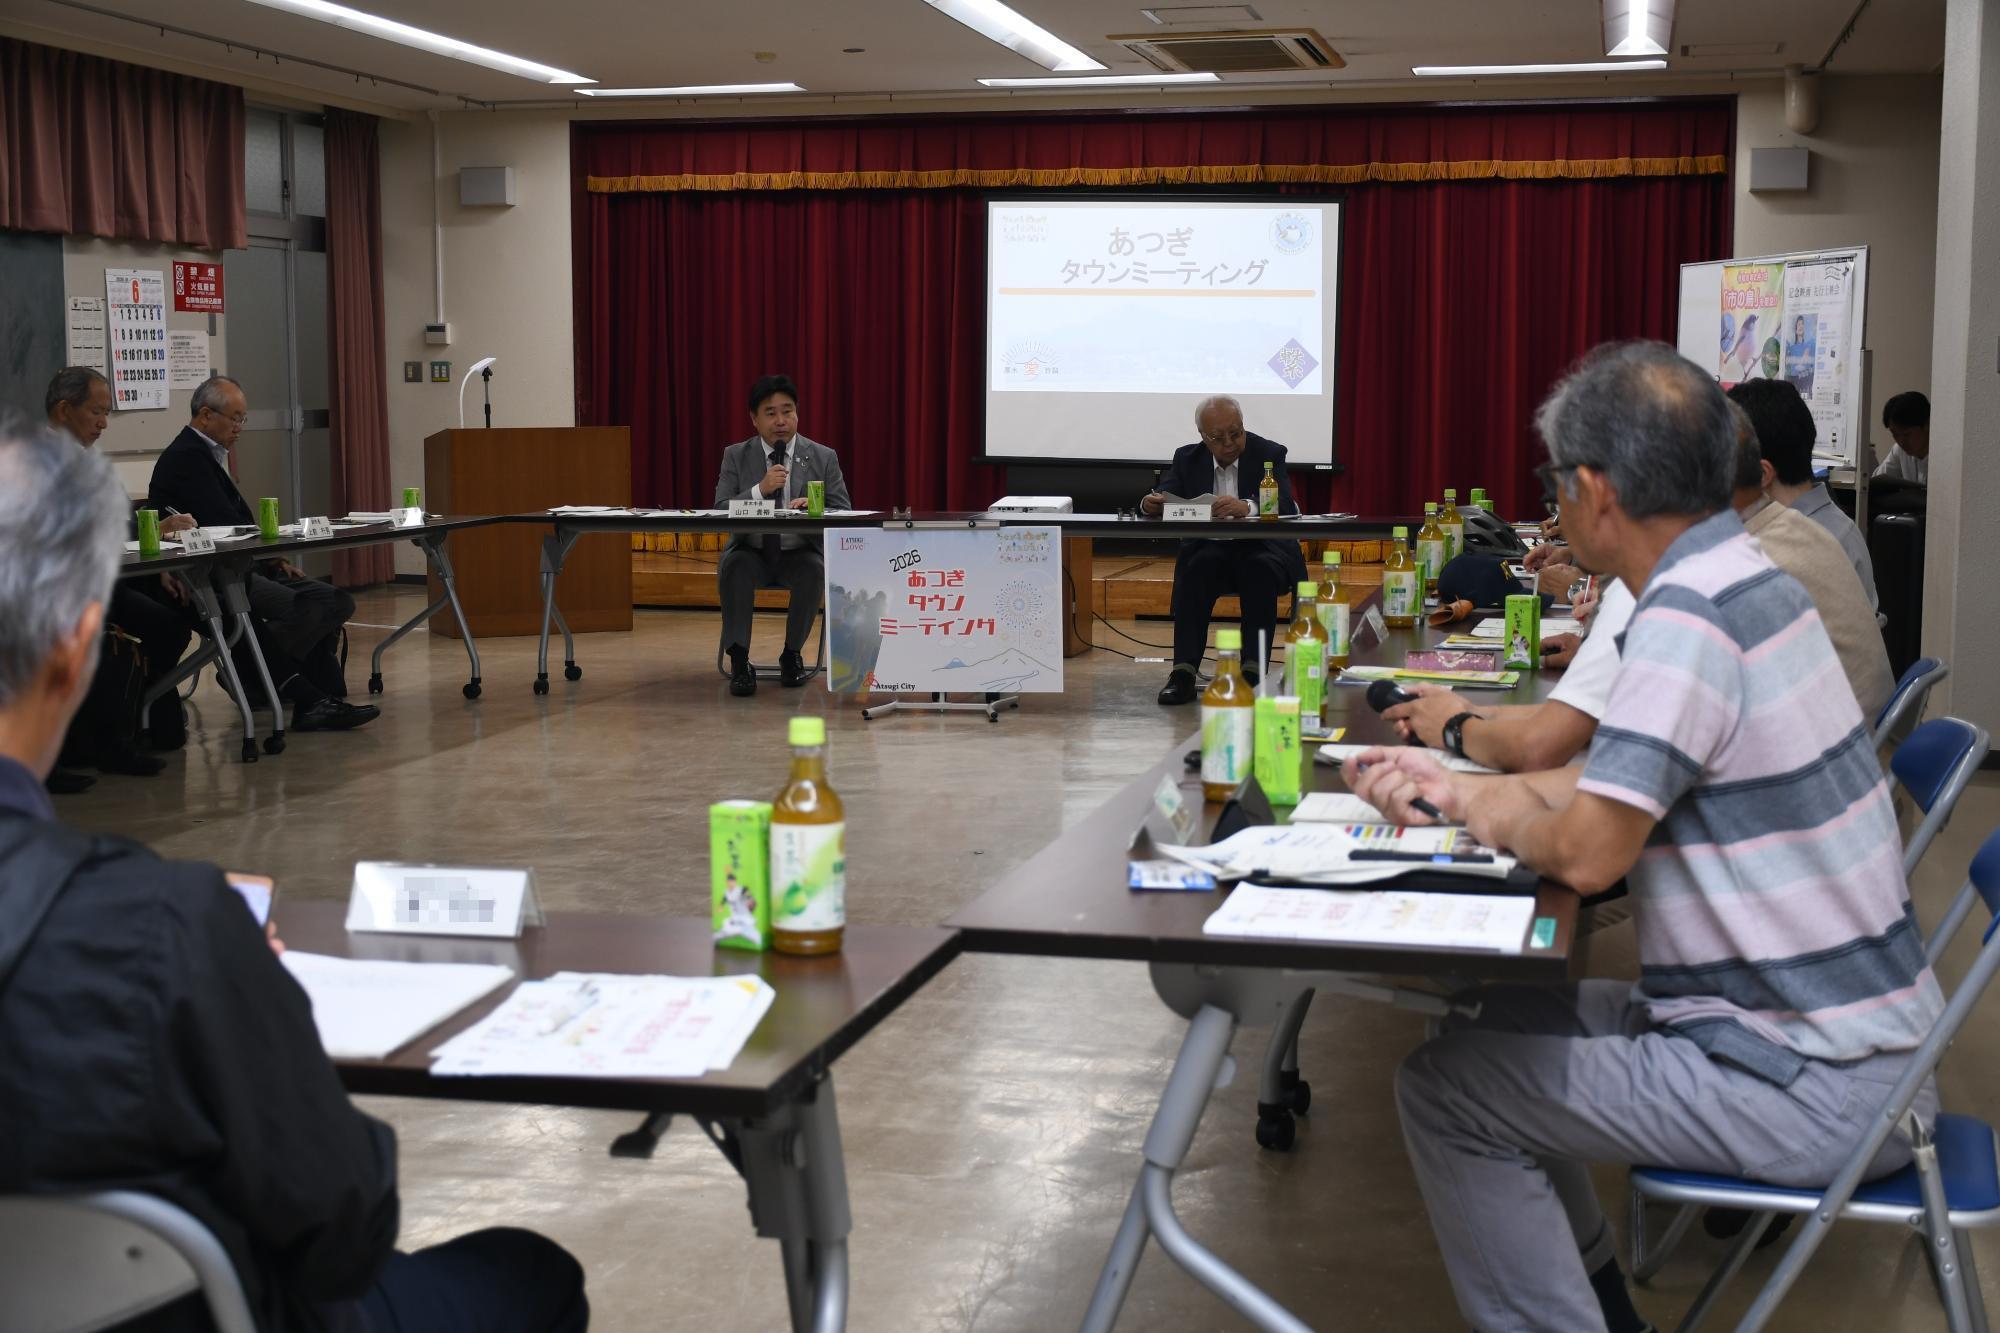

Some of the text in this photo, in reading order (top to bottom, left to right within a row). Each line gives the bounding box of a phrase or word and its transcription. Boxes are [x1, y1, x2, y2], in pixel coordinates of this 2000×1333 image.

[1107, 226, 1194, 257] あつぎ
[1060, 258, 1269, 287] タウンミーティング
[132, 279, 140, 304] 6
[120, 308, 123, 320] 1
[128, 308, 131, 320] 2
[134, 308, 138, 320] 3
[143, 308, 146, 320] 4
[114, 328, 118, 341] 7
[129, 328, 133, 341] 9
[135, 328, 141, 341] 10
[142, 328, 148, 341] 11
[150, 328, 156, 341] 12
[157, 328, 164, 341] 13
[121, 349, 127, 360] 15
[129, 349, 135, 360] 16
[136, 349, 142, 360] 17
[137, 369, 143, 381] 24
[159, 369, 165, 381] 27
[735, 508, 749, 516] 山口
[840, 537, 864, 550] Love
[889, 549, 921, 572] 2026
[908, 570, 965, 588] あつぎ
[908, 594, 965, 611] タウン
[880, 618, 995, 636] ミーティング
[875, 682, 916, 691] Atsugi City
